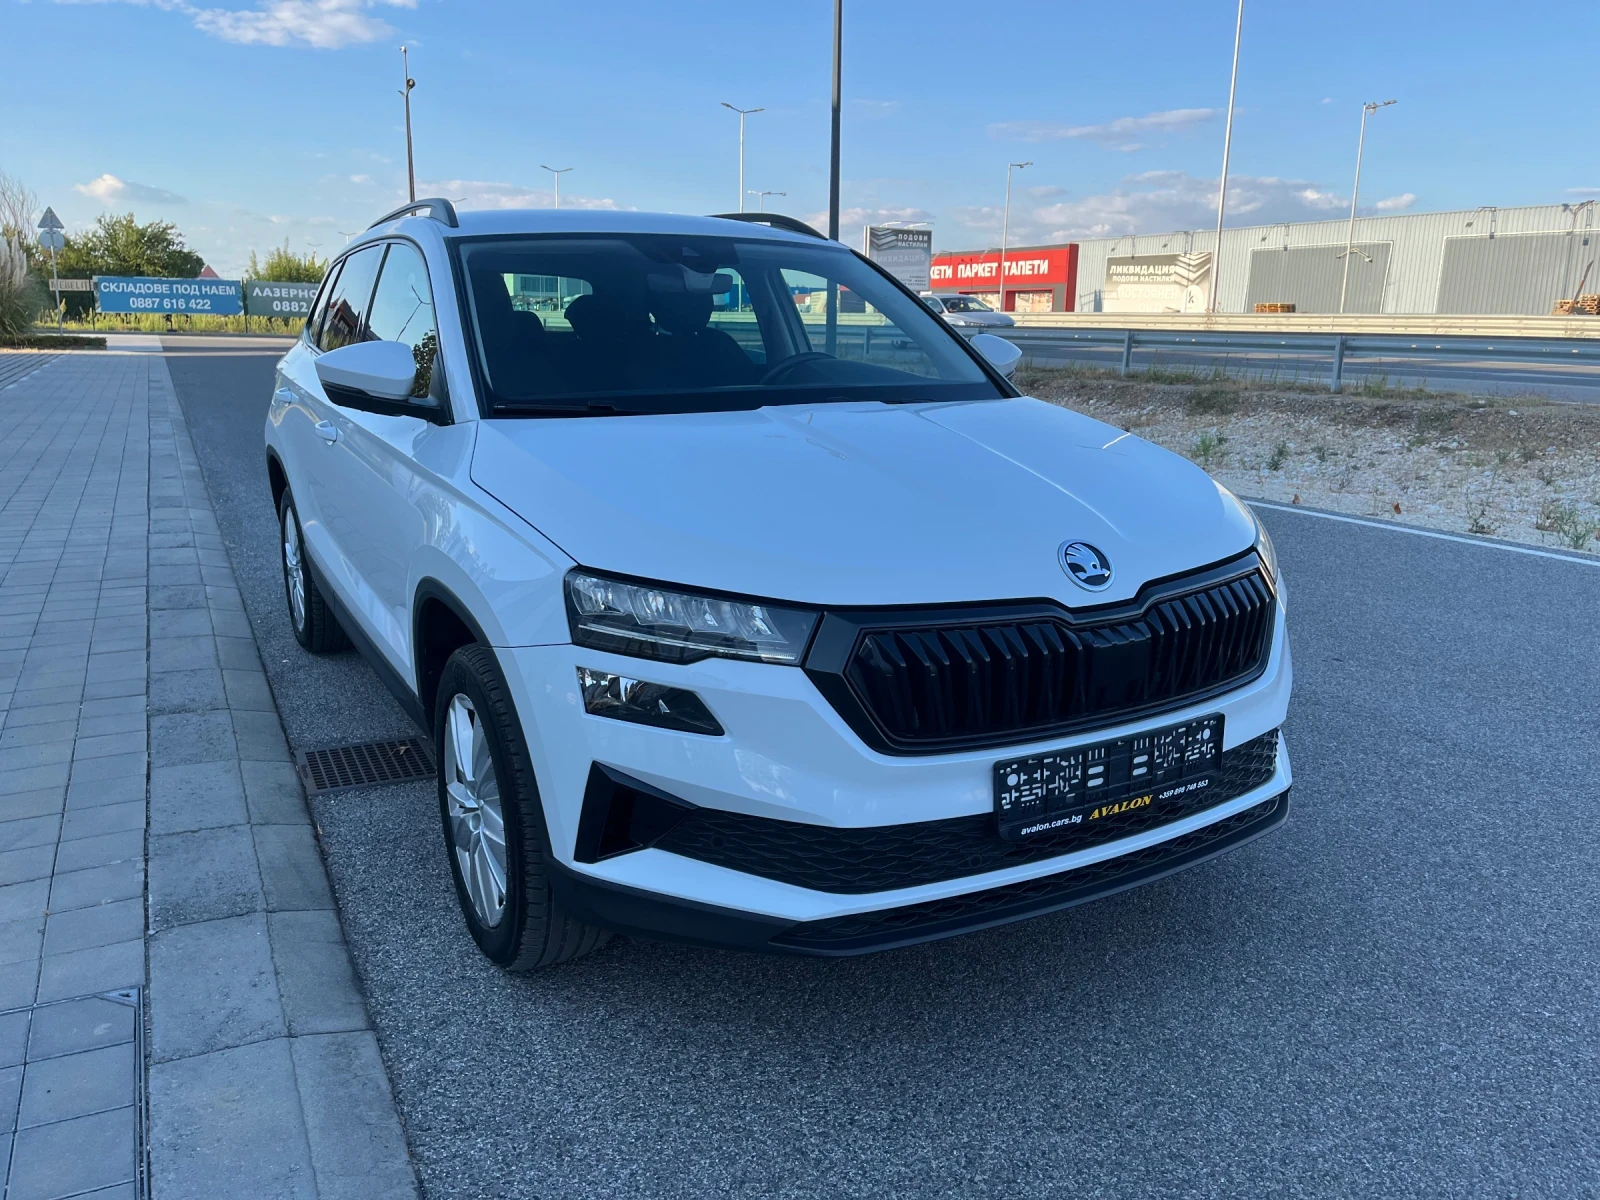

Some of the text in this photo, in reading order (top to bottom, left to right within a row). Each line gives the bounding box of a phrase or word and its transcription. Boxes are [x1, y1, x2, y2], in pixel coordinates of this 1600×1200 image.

[898, 233, 928, 241] ПОДОВИ
[957, 262, 999, 278] ПАРКЕТ
[1003, 259, 1049, 276] ТАПЕТИ
[1109, 265, 1175, 275] ЛИКВИДАЦИЯ
[100, 282, 236, 296] СКЛАДОВЕ ПОД НАЕМ
[129, 297, 211, 310] 0887 616 422
[272, 300, 308, 312] 0882
[1021, 814, 1083, 835] avalon.cars.bg
[1088, 794, 1154, 820] AVALON
